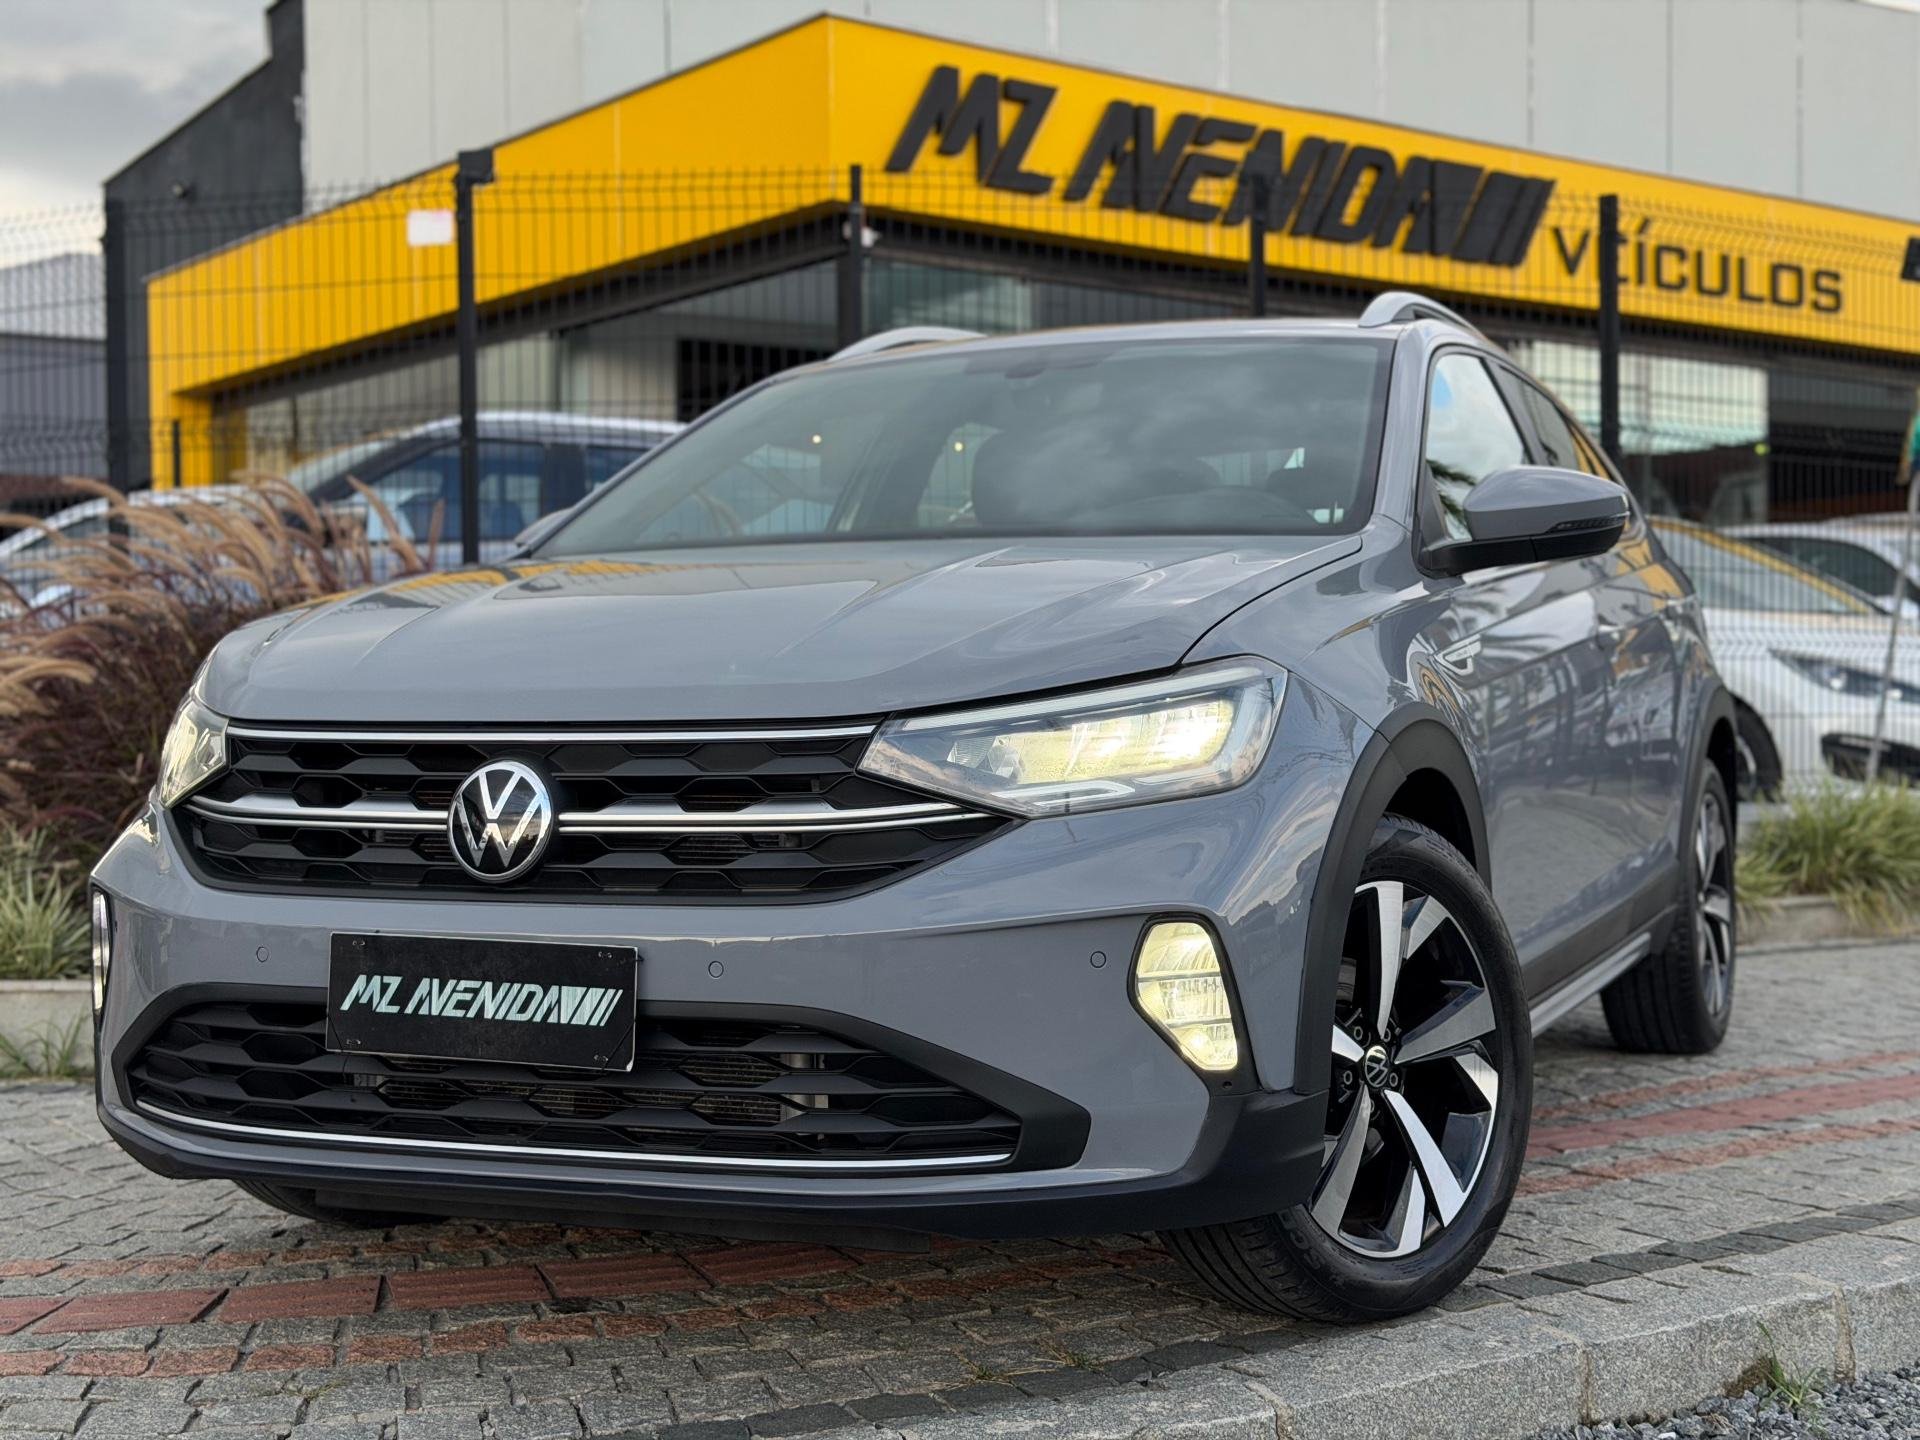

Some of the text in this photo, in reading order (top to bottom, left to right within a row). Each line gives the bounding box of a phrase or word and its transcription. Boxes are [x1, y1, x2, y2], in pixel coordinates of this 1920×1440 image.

[884, 64, 1435, 257] MZ AVENIDA
[340, 974, 560, 1024] MZ AVENIDA
